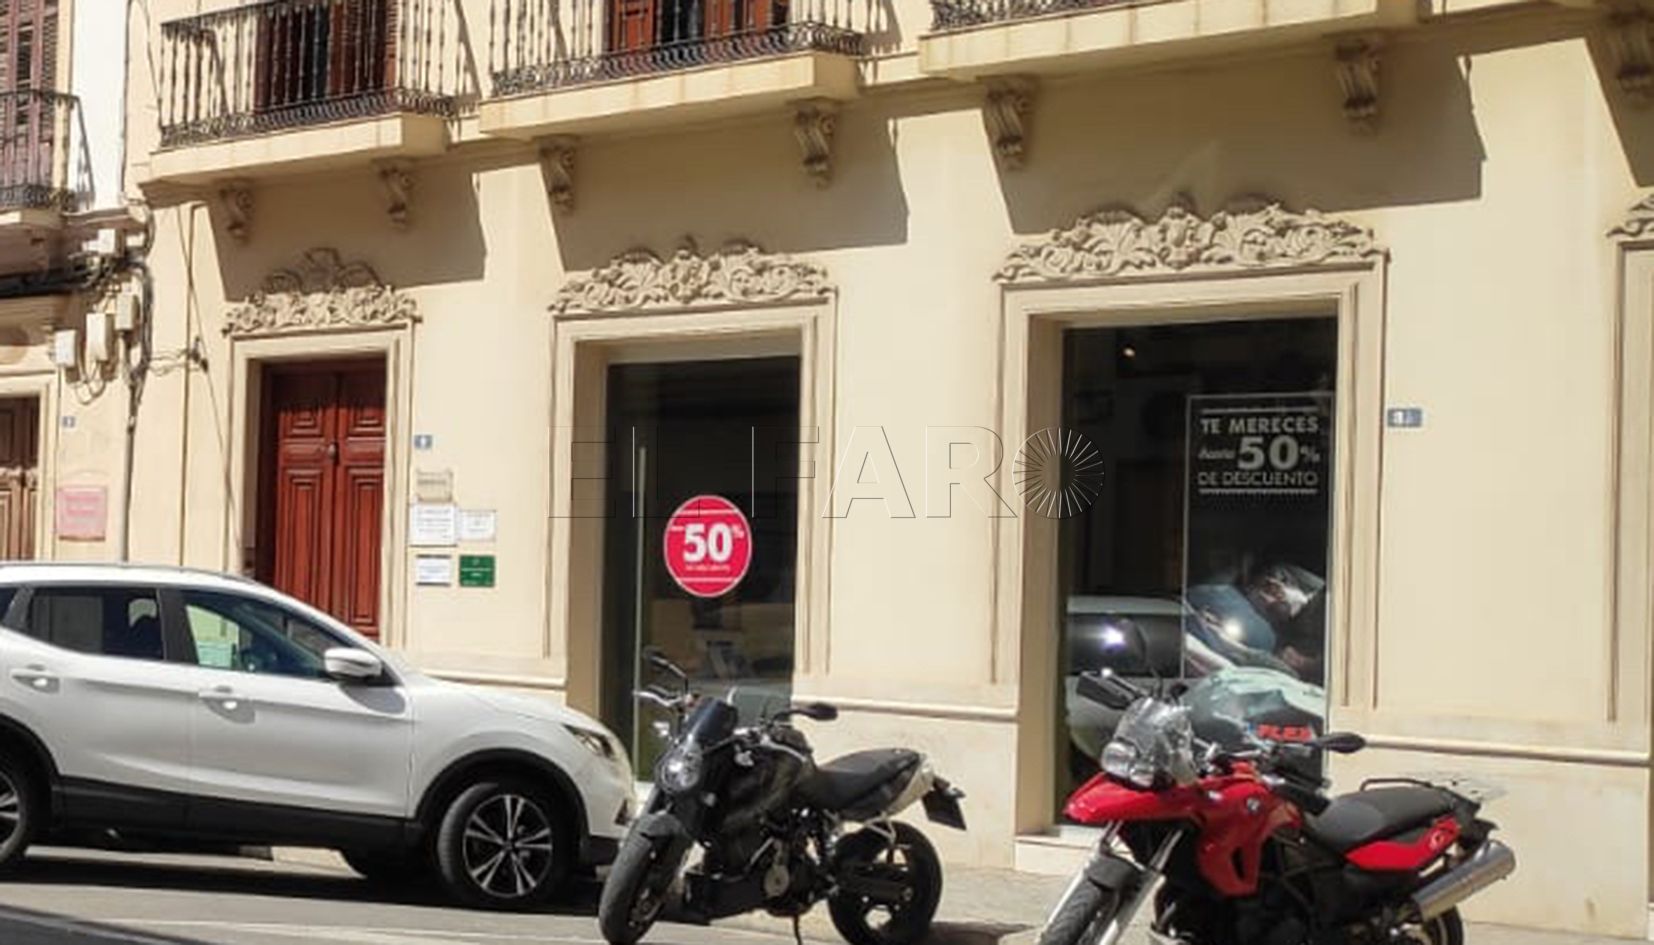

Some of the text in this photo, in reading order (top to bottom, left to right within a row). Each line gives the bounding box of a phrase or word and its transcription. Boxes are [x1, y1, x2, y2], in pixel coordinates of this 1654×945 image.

[1200, 417, 1319, 434] TE MERECES
[1237, 434, 1320, 471] 50%
[1198, 470, 1319, 486] DE DESCUENTO
[683, 523, 745, 563] 50%
